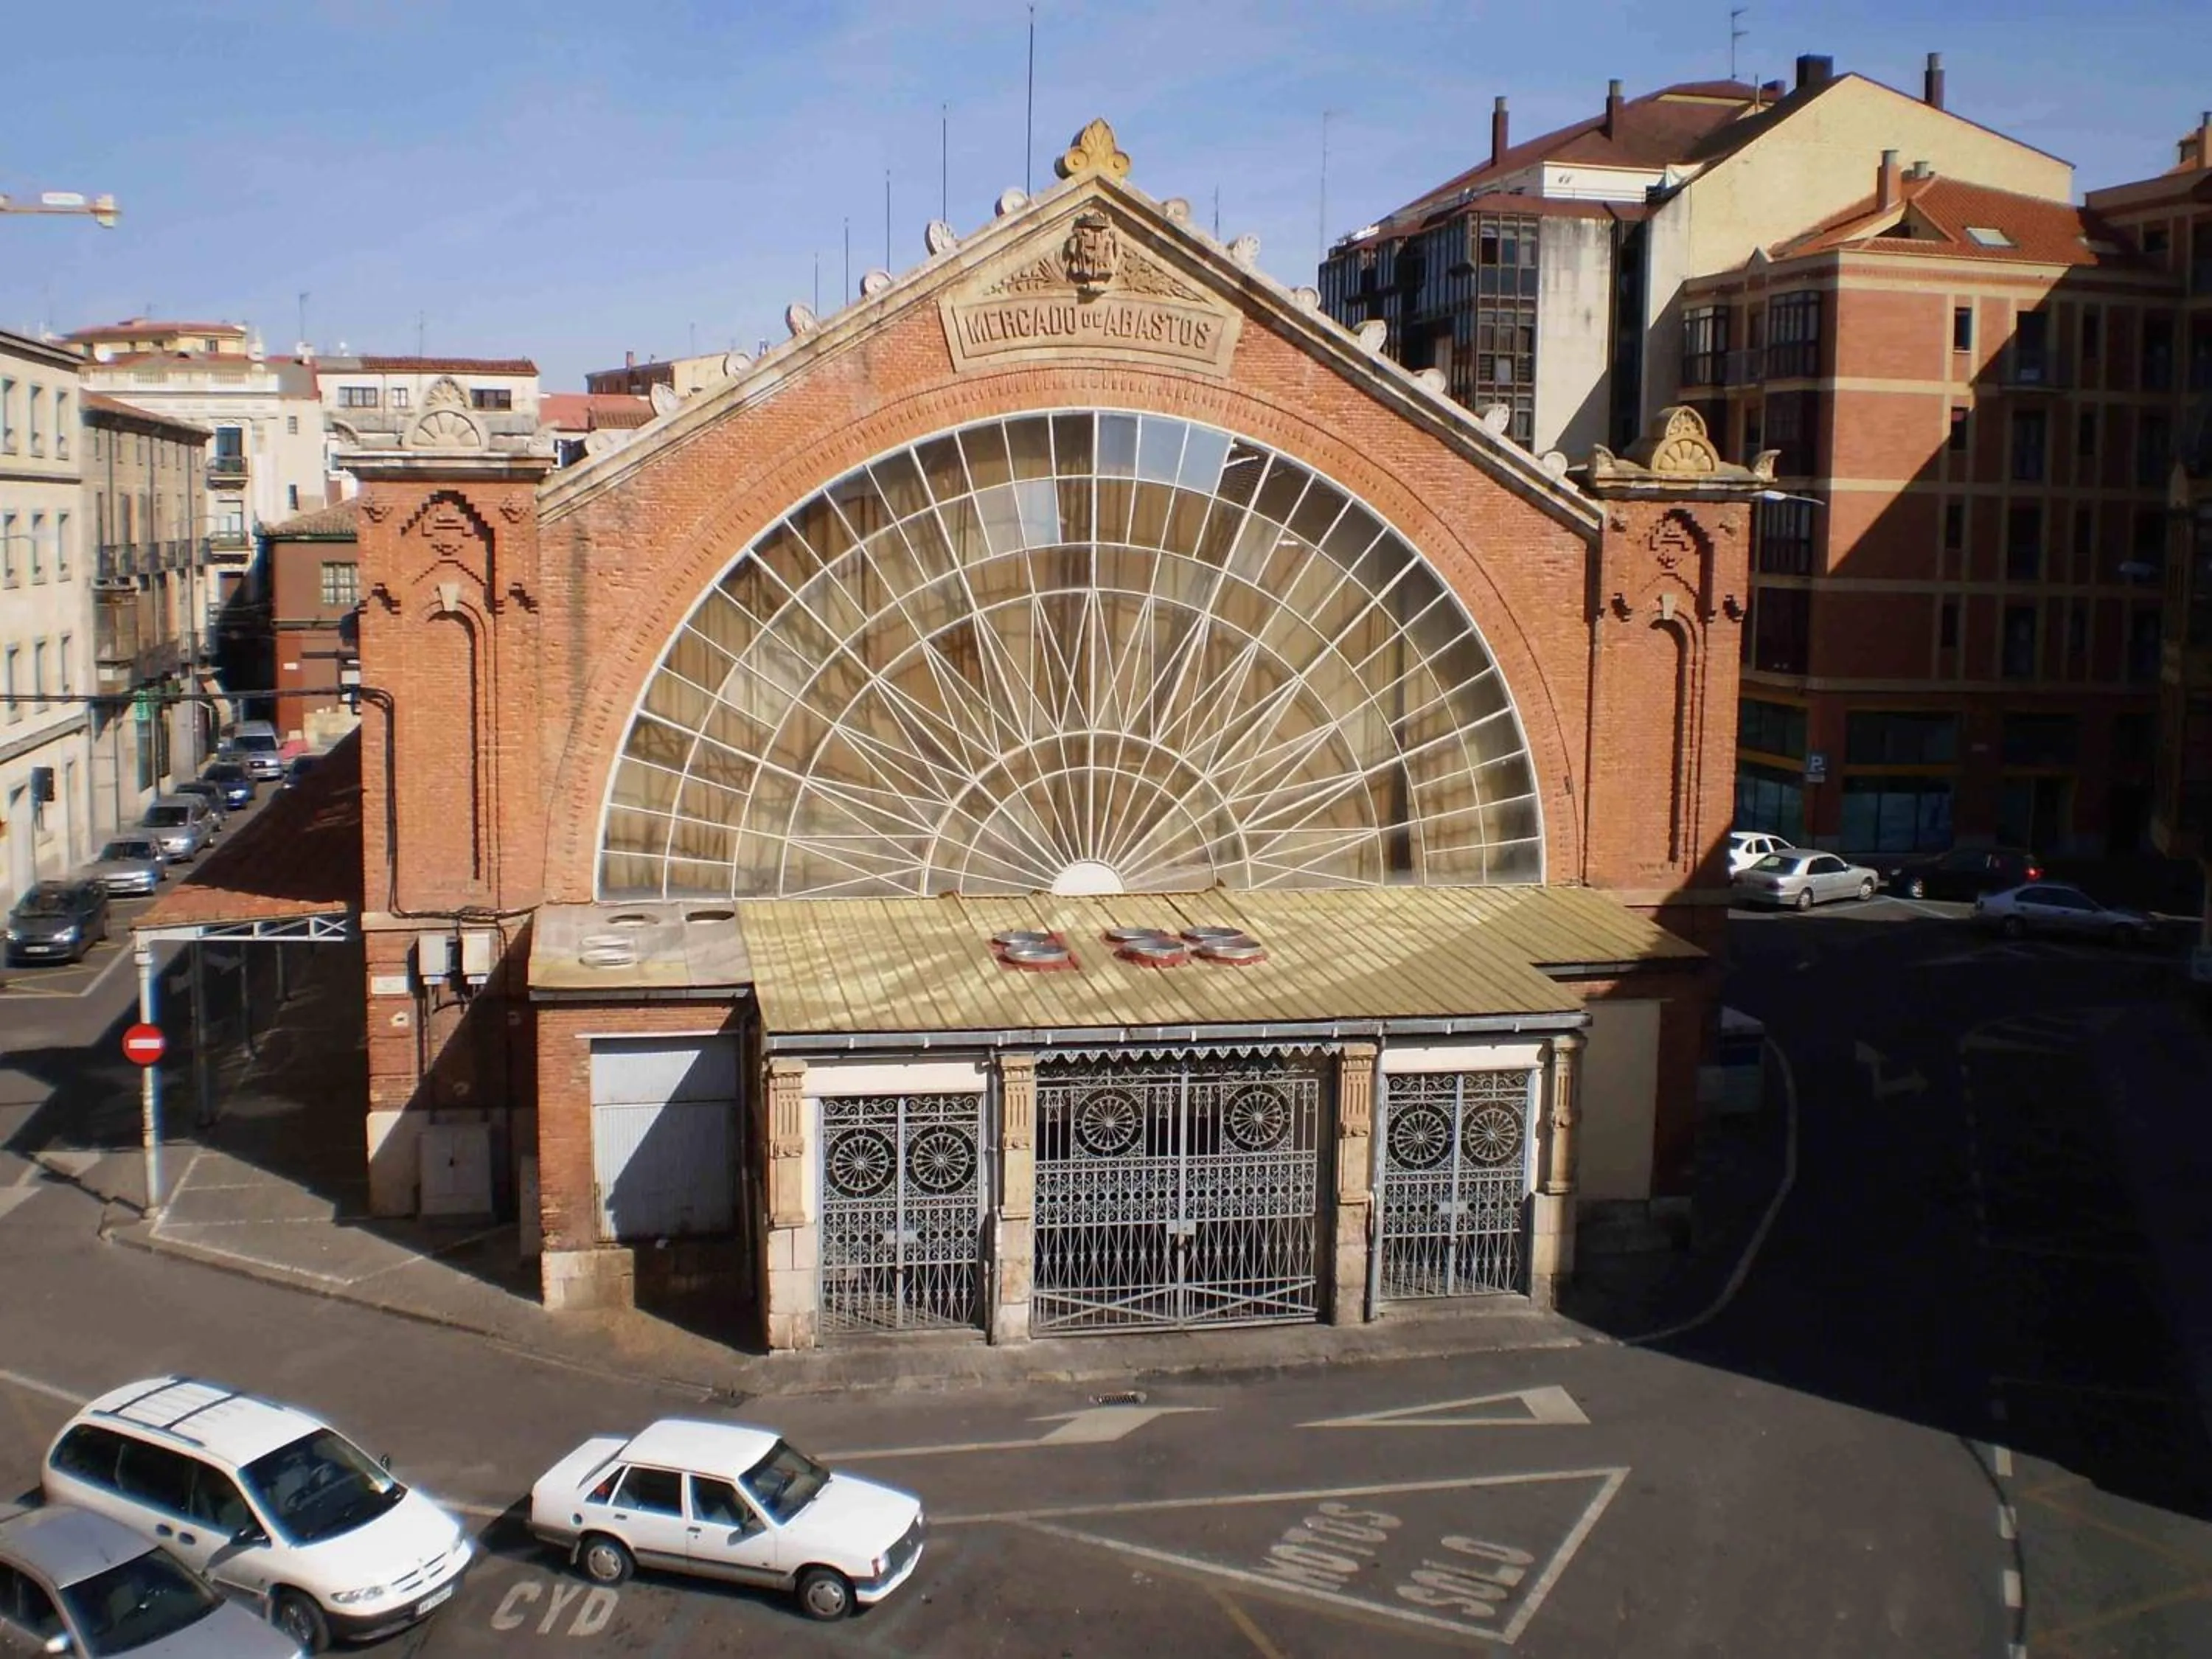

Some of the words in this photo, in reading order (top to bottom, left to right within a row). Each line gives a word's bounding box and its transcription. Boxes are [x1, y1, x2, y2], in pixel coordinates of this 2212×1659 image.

[965, 305, 1077, 344] MERCADO
[1103, 305, 1211, 349] ABASTOS
[1396, 1535, 1535, 1618] SOLO
[490, 1581, 621, 1637] CYD
